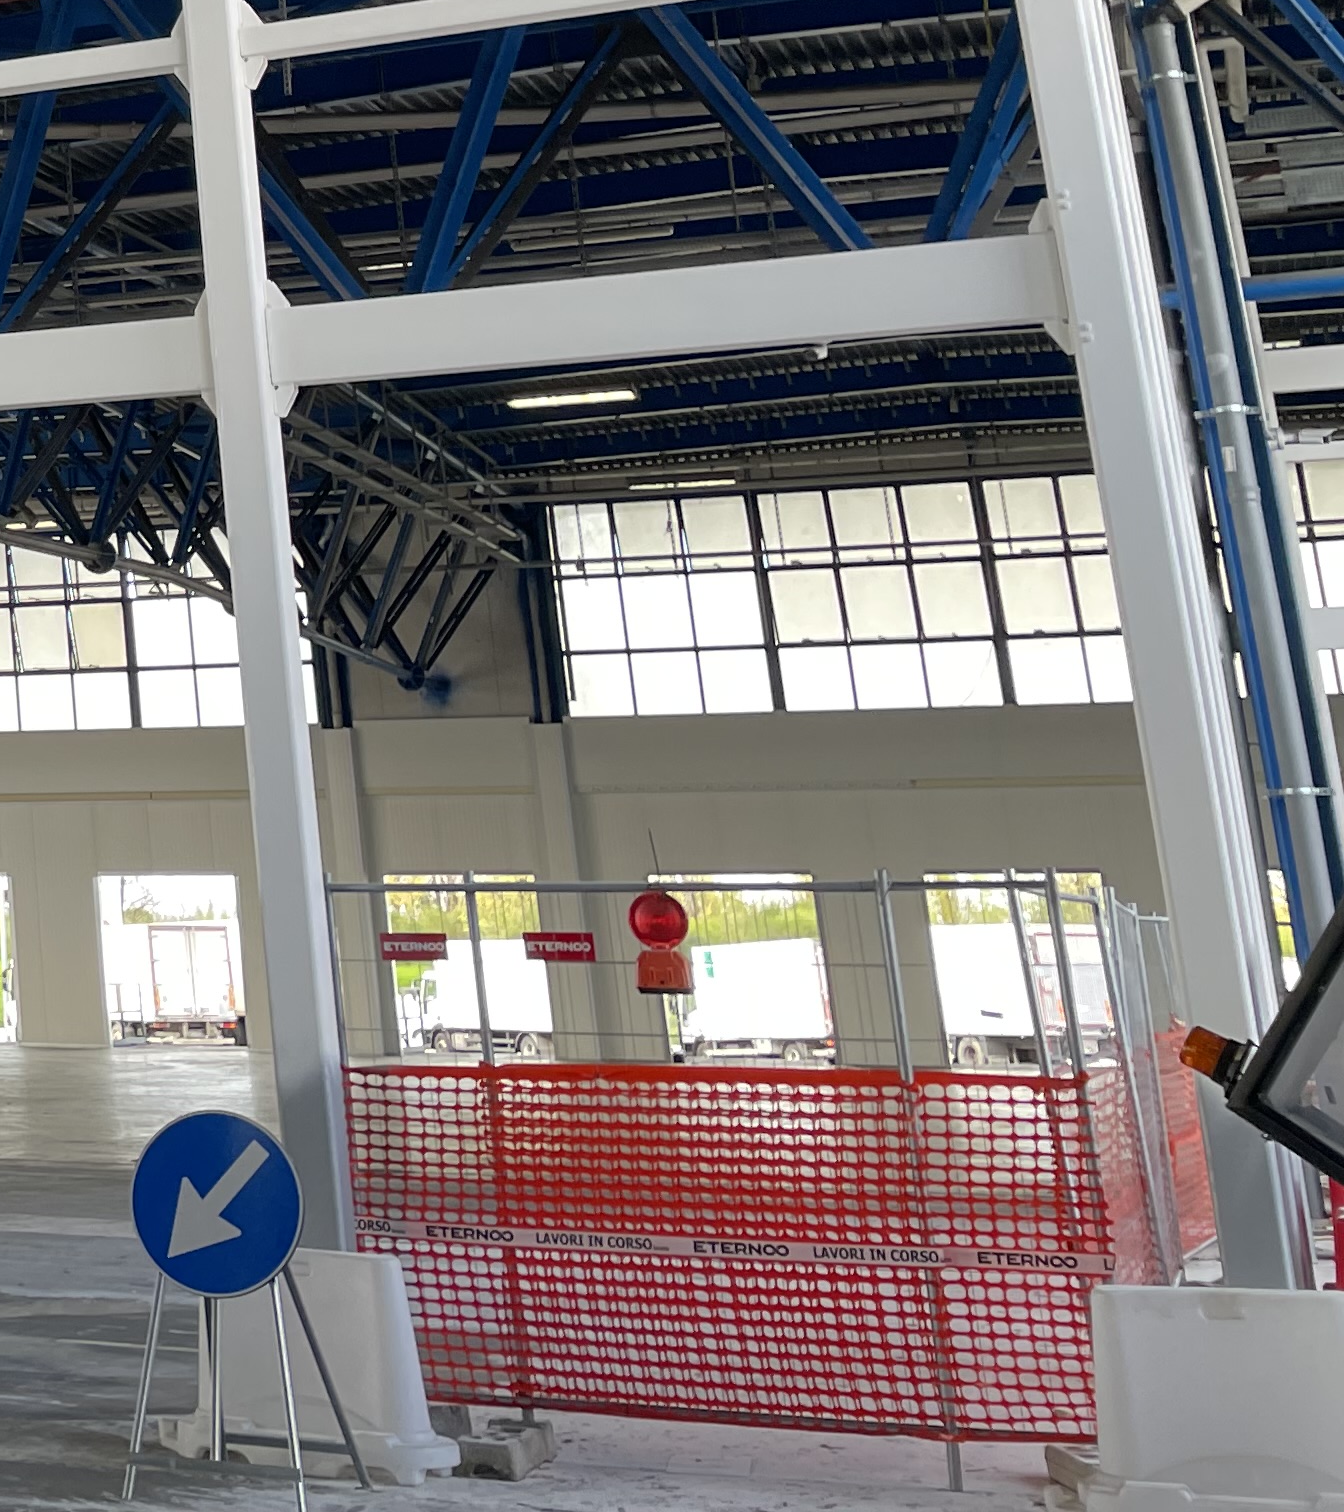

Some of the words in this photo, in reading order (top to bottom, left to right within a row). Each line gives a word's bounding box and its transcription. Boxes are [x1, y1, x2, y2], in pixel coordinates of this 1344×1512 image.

[536, 1232, 584, 1247] LAVORI
[589, 1234, 604, 1248] IN
[813, 1246, 866, 1261] LAVORI
[869, 1249, 887, 1262] IN
